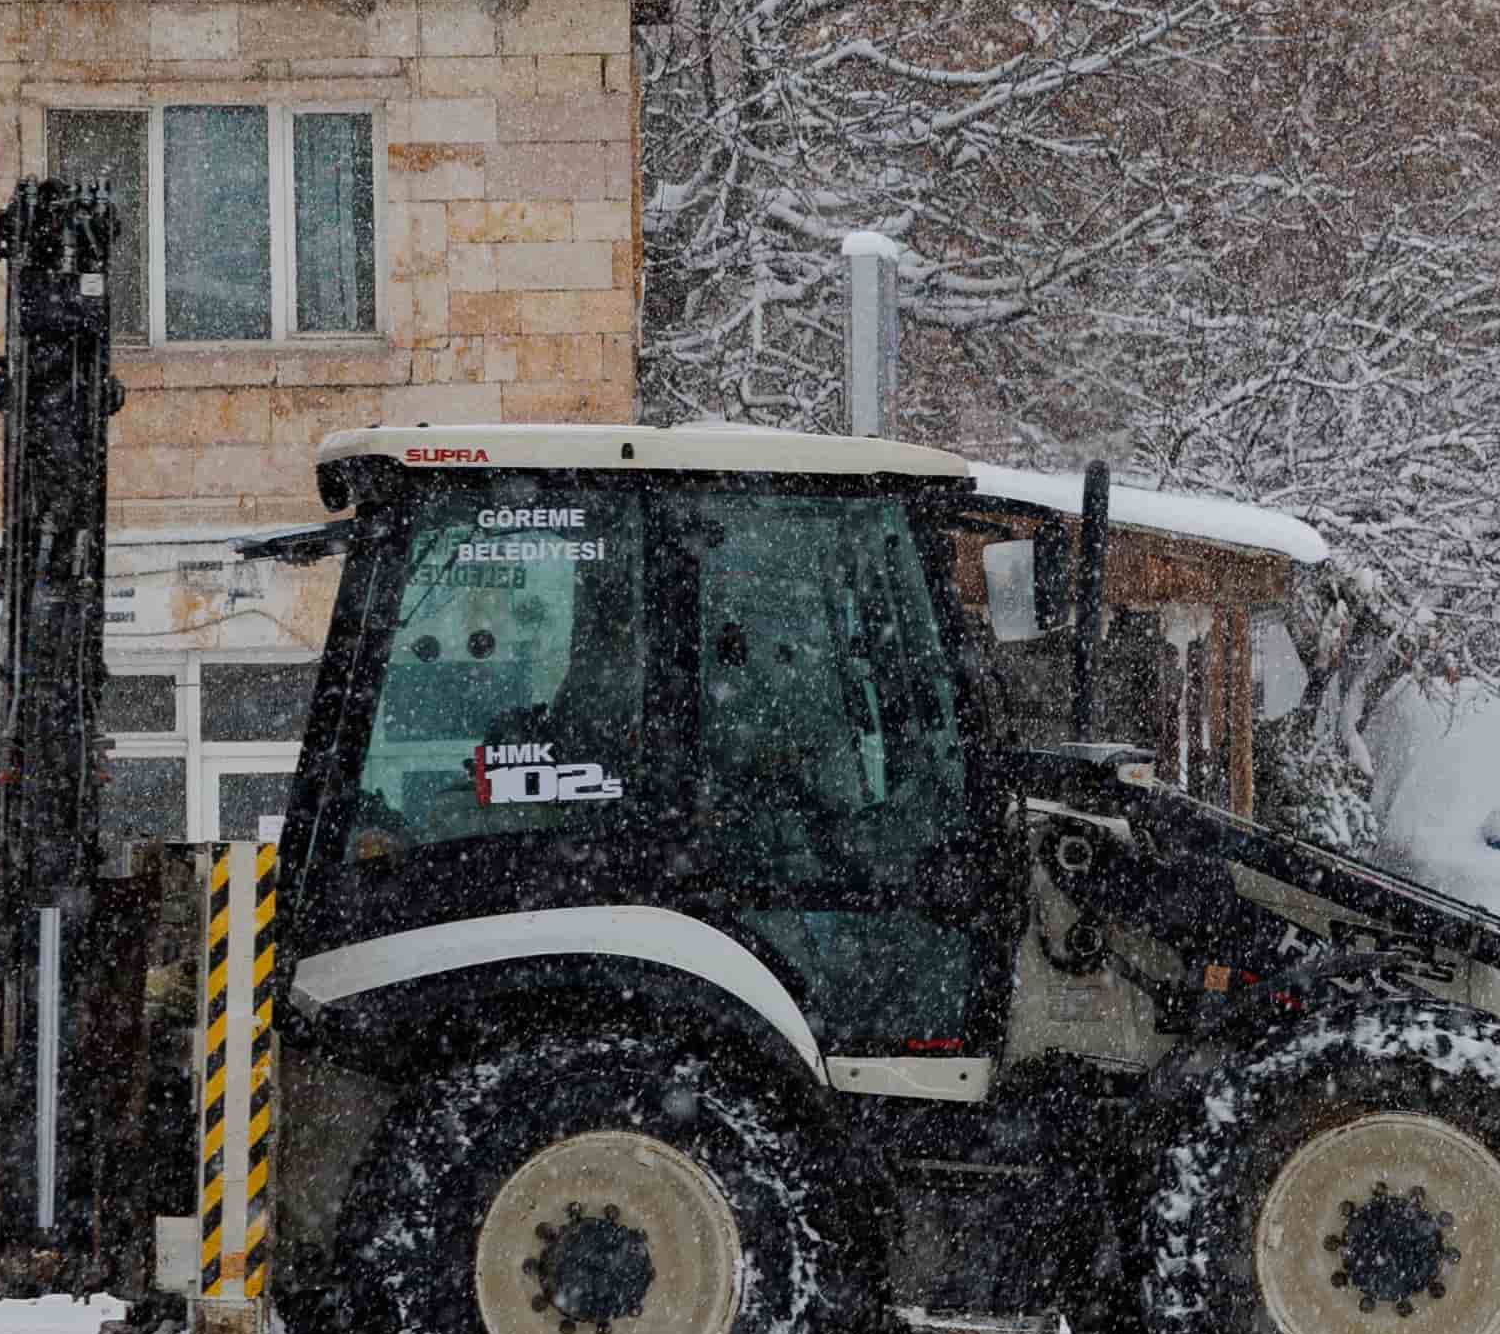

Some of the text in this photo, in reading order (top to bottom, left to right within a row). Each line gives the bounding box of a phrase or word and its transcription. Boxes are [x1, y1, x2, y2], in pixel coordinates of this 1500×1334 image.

[405, 448, 489, 463] SUPRA
[477, 505, 586, 528] GÖREME
[457, 538, 605, 562] BELEDİYESİ
[485, 743, 555, 764] HMK
